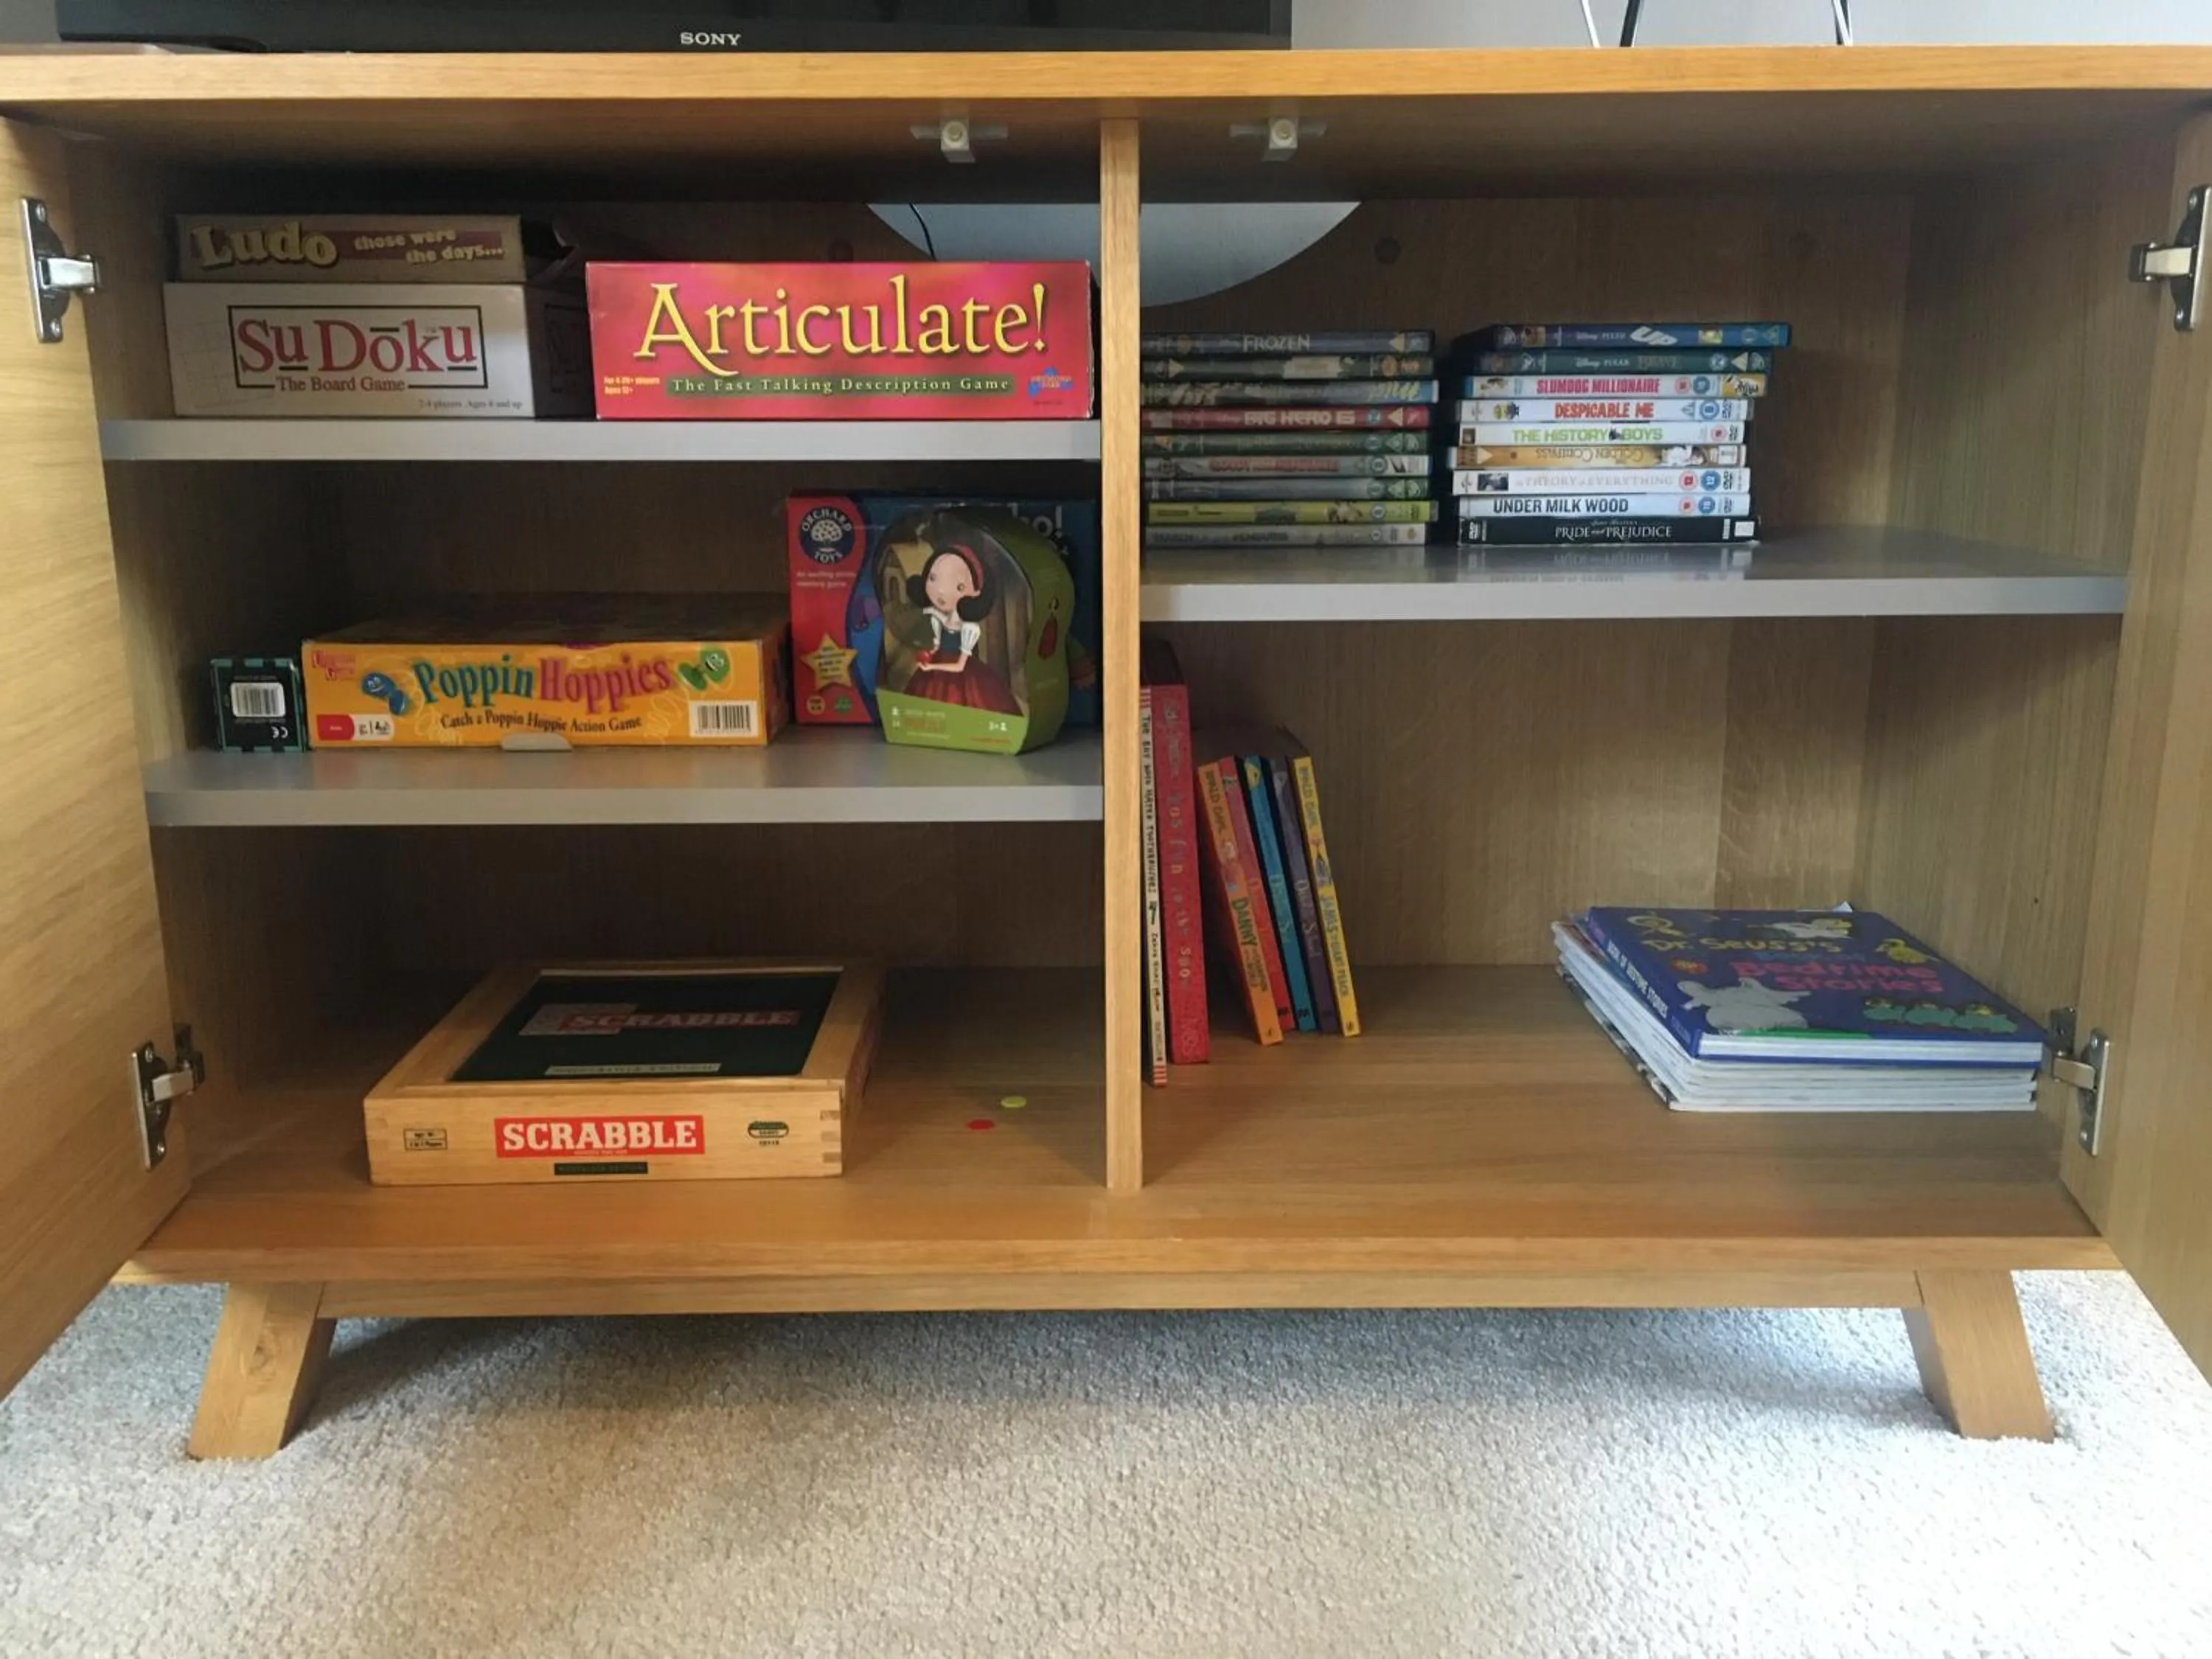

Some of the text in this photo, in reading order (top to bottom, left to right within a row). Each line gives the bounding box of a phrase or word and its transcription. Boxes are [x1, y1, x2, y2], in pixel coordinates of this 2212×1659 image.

[681, 32, 741, 46] SONY
[192, 222, 338, 268] Ludo
[354, 230, 456, 250] those were
[407, 249, 437, 262] the
[633, 274, 1046, 377] Articulate!
[1243, 334, 1310, 352] FROZEN
[276, 375, 406, 392] The Board Game
[672, 377, 1009, 394] The Fast Talking Description Game
[1537, 378, 1660, 394] SLUMDOG MILLIONAIRE
[1244, 410, 1276, 425] BIG
[1280, 409, 1331, 425] HERO
[1336, 410, 1355, 425] 6
[1555, 402, 1655, 418] DESPICABLE ME
[1513, 428, 1663, 442] THE HISTORY BOYS
[1493, 498, 1629, 514] UNDER MILK WOOD
[801, 507, 852, 532] ORCHARD
[1554, 526, 1590, 540] PRIDE
[1605, 526, 1672, 540] PREJUDICE
[815, 551, 844, 564] TOYS
[412, 654, 535, 708] Poppin
[539, 654, 676, 714] Hoppies
[441, 710, 473, 728] Catch
[484, 709, 524, 728] Poppin
[527, 712, 568, 731] Hoppie
[570, 717, 605, 732] Action
[608, 716, 641, 731] Game
[1231, 897, 1258, 947] DANNY
[1699, 937, 1842, 953] Seuss's
[1729, 961, 1938, 978] Bedtime
[1775, 976, 1944, 992] Stories
[568, 1012, 794, 1028] SCRABBLE
[503, 1120, 697, 1150] SCRABBLE
